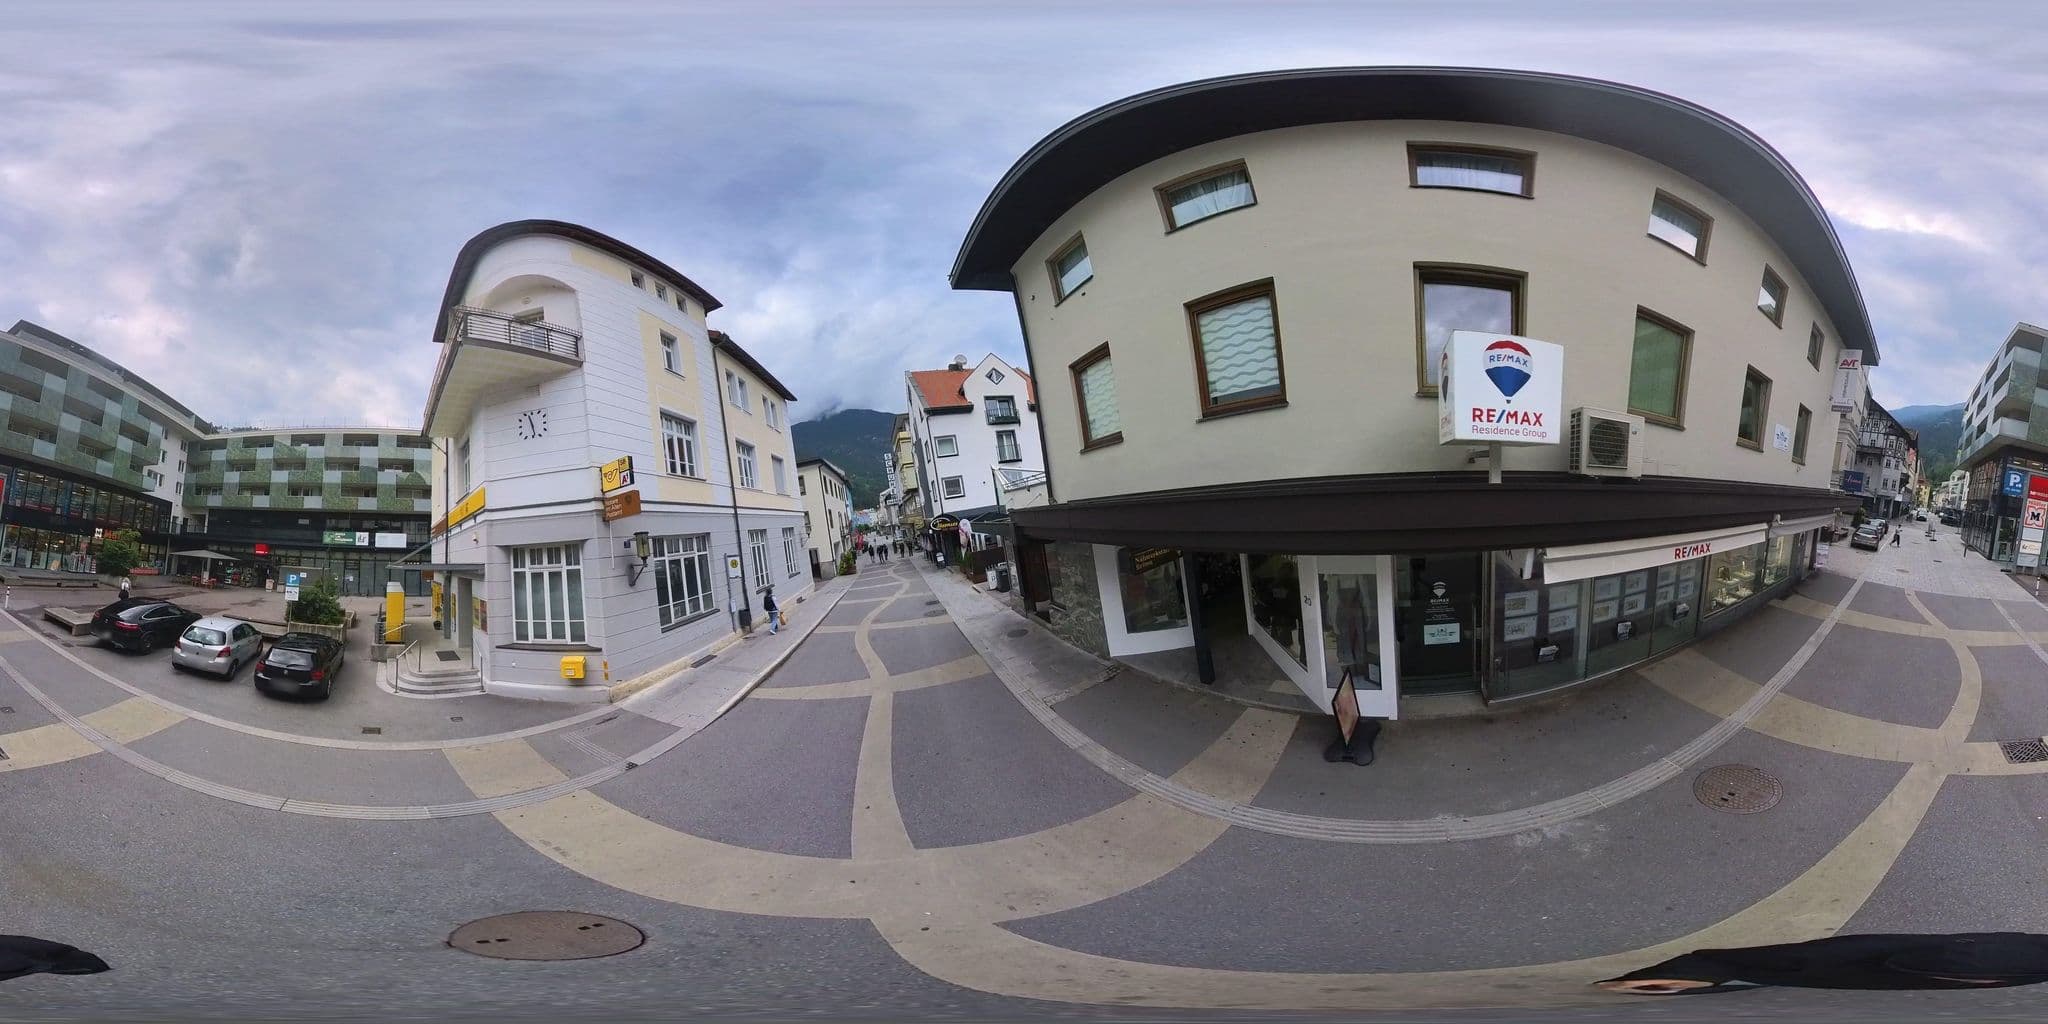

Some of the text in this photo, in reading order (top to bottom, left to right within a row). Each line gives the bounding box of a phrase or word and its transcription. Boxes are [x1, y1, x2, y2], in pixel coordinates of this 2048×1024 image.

[1489, 354, 1528, 367] RE/MAX
[1472, 408, 1543, 427] RE/MAX
[1472, 424, 1547, 438] Residence Group
[1674, 543, 1711, 560] RE/MAX
